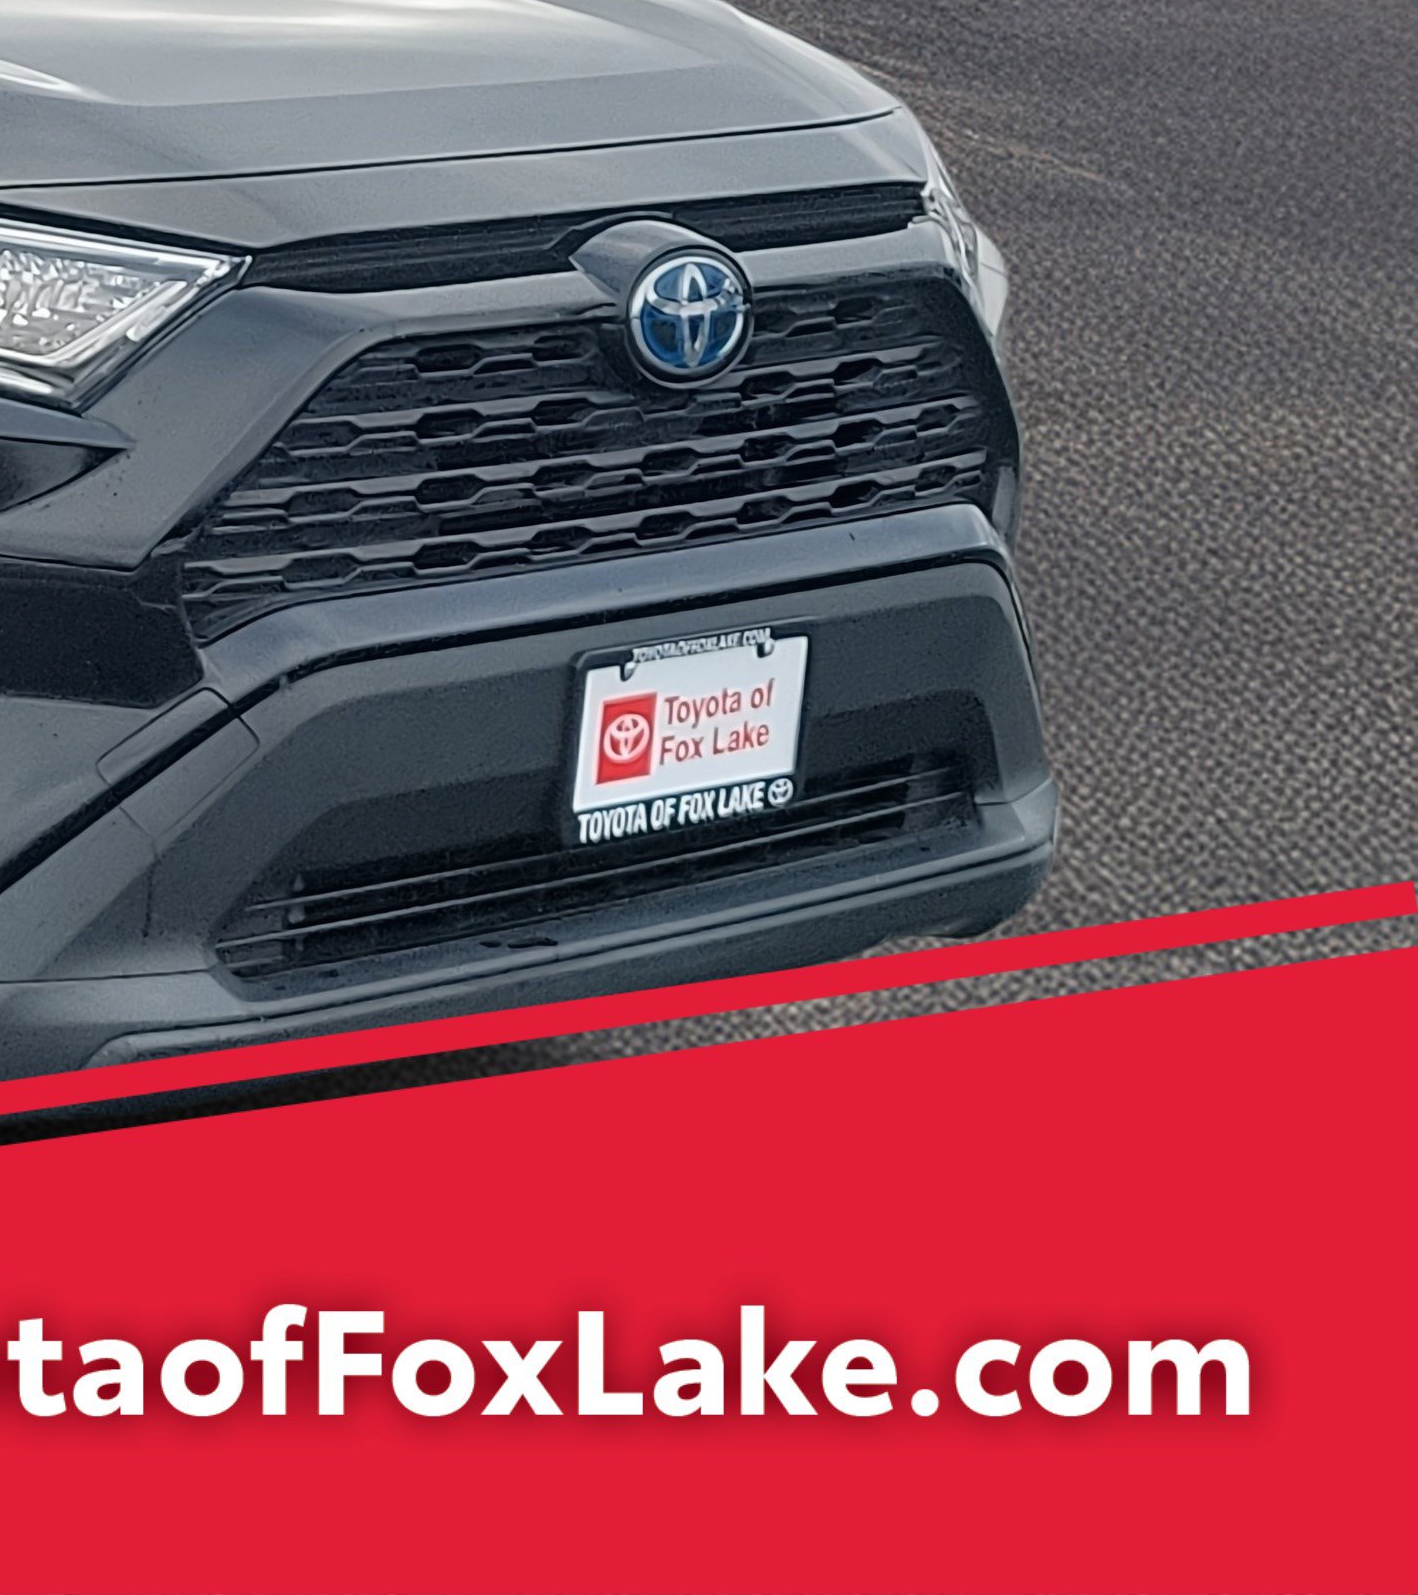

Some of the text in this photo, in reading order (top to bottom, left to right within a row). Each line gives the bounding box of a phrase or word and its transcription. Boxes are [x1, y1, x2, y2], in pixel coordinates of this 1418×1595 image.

[664, 677, 775, 729] Toyota of
[659, 720, 770, 766] Fox Lake
[578, 781, 765, 844] TOYOTA OF FOX LAKE
